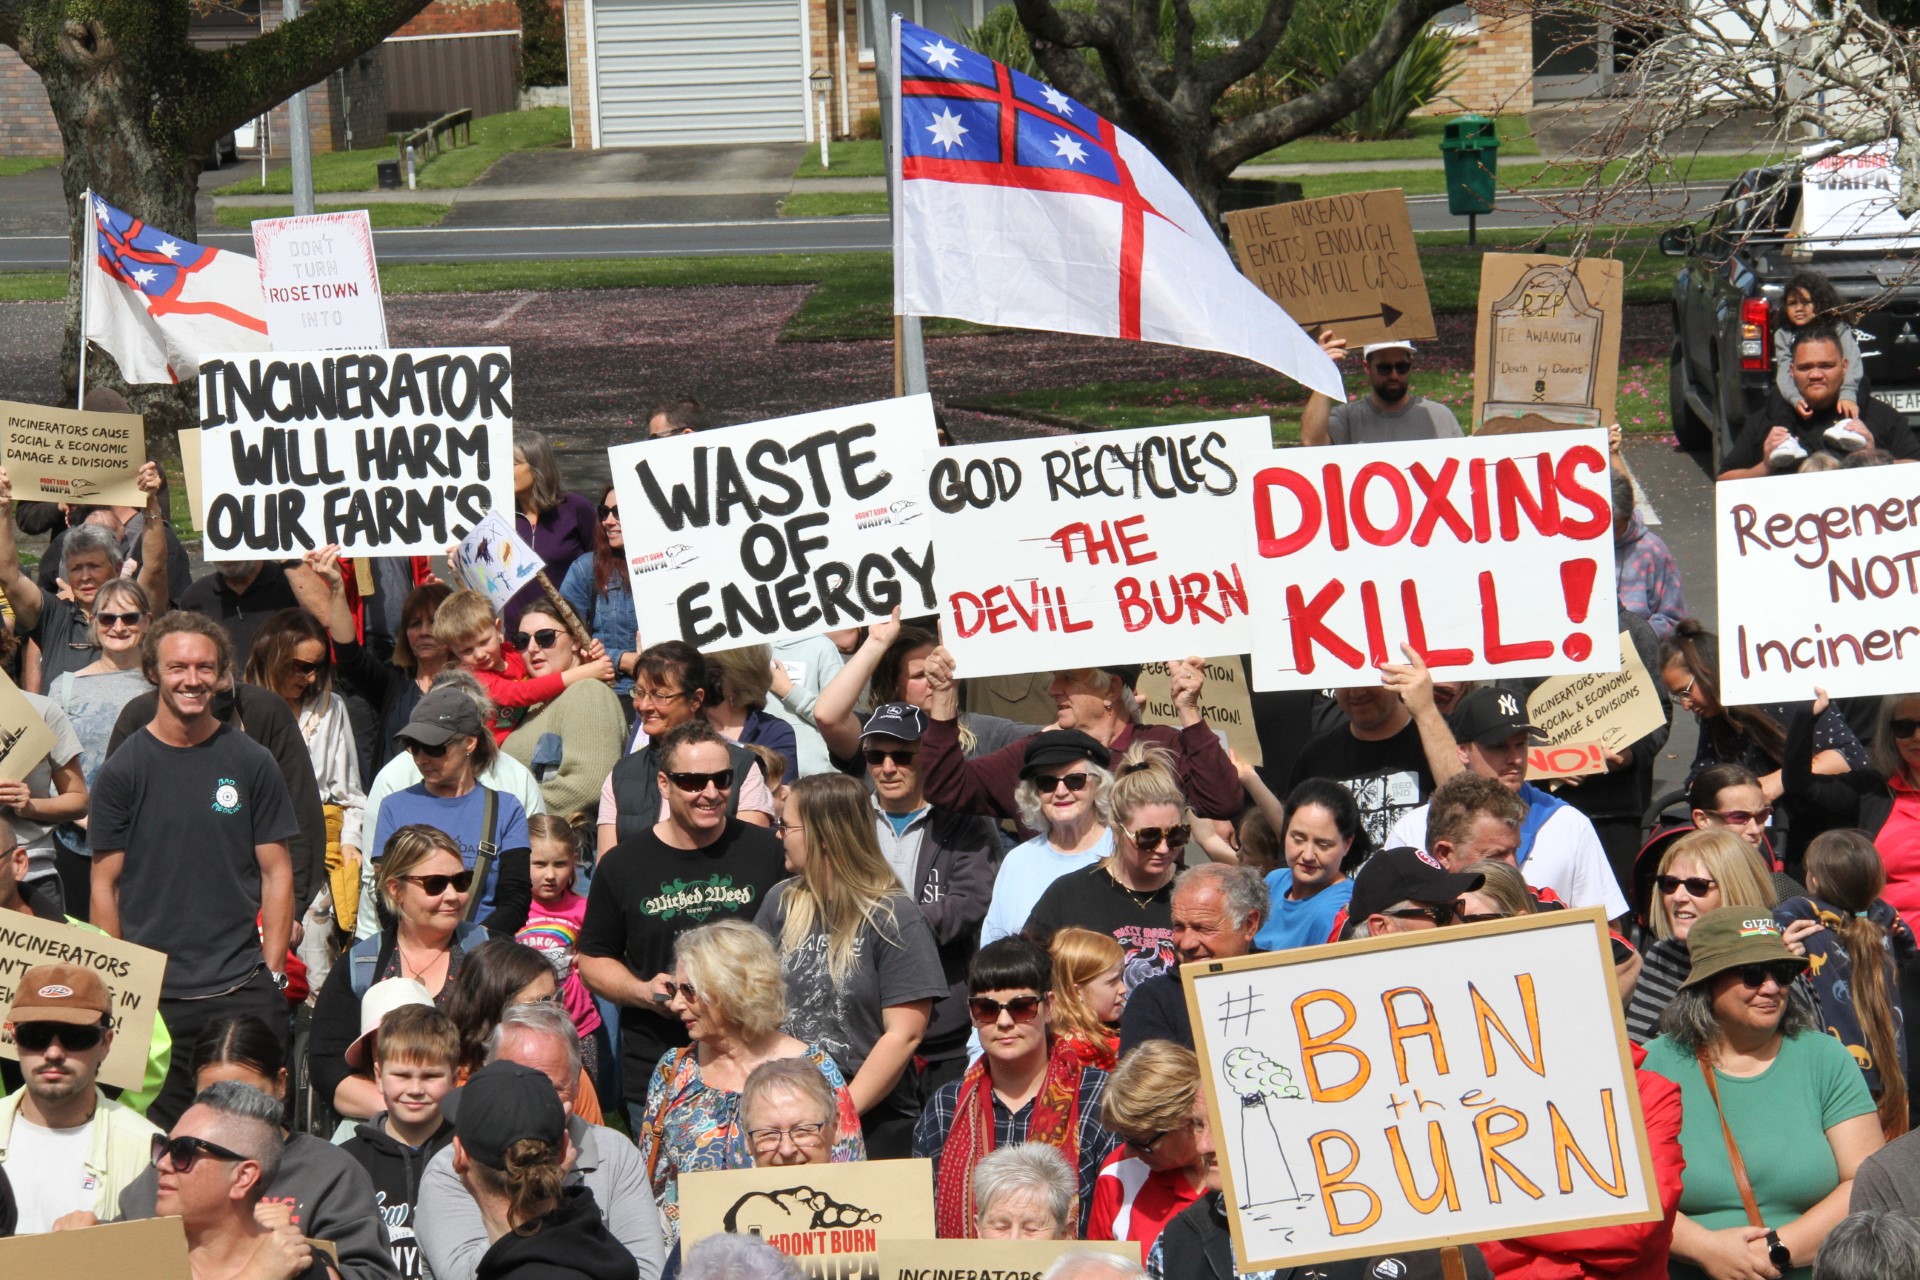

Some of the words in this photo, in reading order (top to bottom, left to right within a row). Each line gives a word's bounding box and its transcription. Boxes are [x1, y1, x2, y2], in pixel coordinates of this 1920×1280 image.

[1817, 171, 1890, 190] WAIPA
[1246, 212, 1276, 239] HE
[1292, 193, 1369, 226] ALREADY
[289, 233, 334, 257] DON'T
[1247, 236, 1306, 267] EMITS
[1316, 224, 1395, 256] ENOUGH
[293, 260, 339, 278] TURN
[1259, 261, 1358, 299] HARMFUL
[269, 281, 359, 303] ROSETOWN
[1521, 293, 1564, 317] RIP
[301, 310, 343, 328] INTO
[1500, 327, 1515, 342] TE
[1526, 330, 1581, 344] AWAMUTU
[201, 351, 512, 431] INCINERATOR
[1538, 364, 1547, 379] by
[8, 416, 88, 436] INCINERATORS
[92, 427, 129, 439] CAUSE
[11, 433, 51, 448] SOCIAL
[55, 440, 64, 449] &
[69, 441, 128, 454] ECONOMIC
[7, 448, 54, 464] DAMAGE
[58, 456, 68, 465] &
[71, 456, 129, 469] DIVISIONS
[231, 427, 345, 487] WILL
[356, 424, 489, 482] HARM
[929, 457, 1022, 513] GOD
[1042, 431, 1238, 502] RECYCLES
[636, 423, 891, 532] WASTE
[206, 494, 315, 551] OUR
[324, 484, 493, 547] FARM'S
[1253, 444, 1612, 558] DIOXINS
[857, 515, 891, 530] WAIPA
[1050, 515, 1158, 566] THE
[1730, 496, 1920, 569] Regener
[741, 512, 830, 582] OF
[633, 560, 668, 575] WAIPA
[1828, 550, 1920, 603] NOT
[678, 541, 937, 646] ENERGY
[949, 579, 1094, 639] DEVIL
[1115, 563, 1249, 634] BURN
[1284, 557, 1598, 675] KILL!
[1738, 623, 1920, 679] Inciner
[1532, 672, 1595, 719] INCINERATORS
[1541, 706, 1574, 733] SOCIAL
[1576, 701, 1585, 713] &
[1585, 669, 1633, 706] ECONOMIC
[1586, 714, 1595, 727] &
[1594, 685, 1641, 719] DIVISIONS
[1528, 744, 1601, 773] NO!
[218, 778, 236, 787] BAD
[1392, 781, 1412, 790] RED
[646, 886, 703, 914] Wicked
[704, 885, 751, 904] Weed
[120, 990, 141, 1010] IN
[1290, 973, 1546, 1104] BAN
[1387, 1087, 1497, 1117] the
[1307, 1088, 1628, 1237] BURN
[767, 1231, 826, 1257] #DON'T
[831, 1228, 877, 1254] BURN
